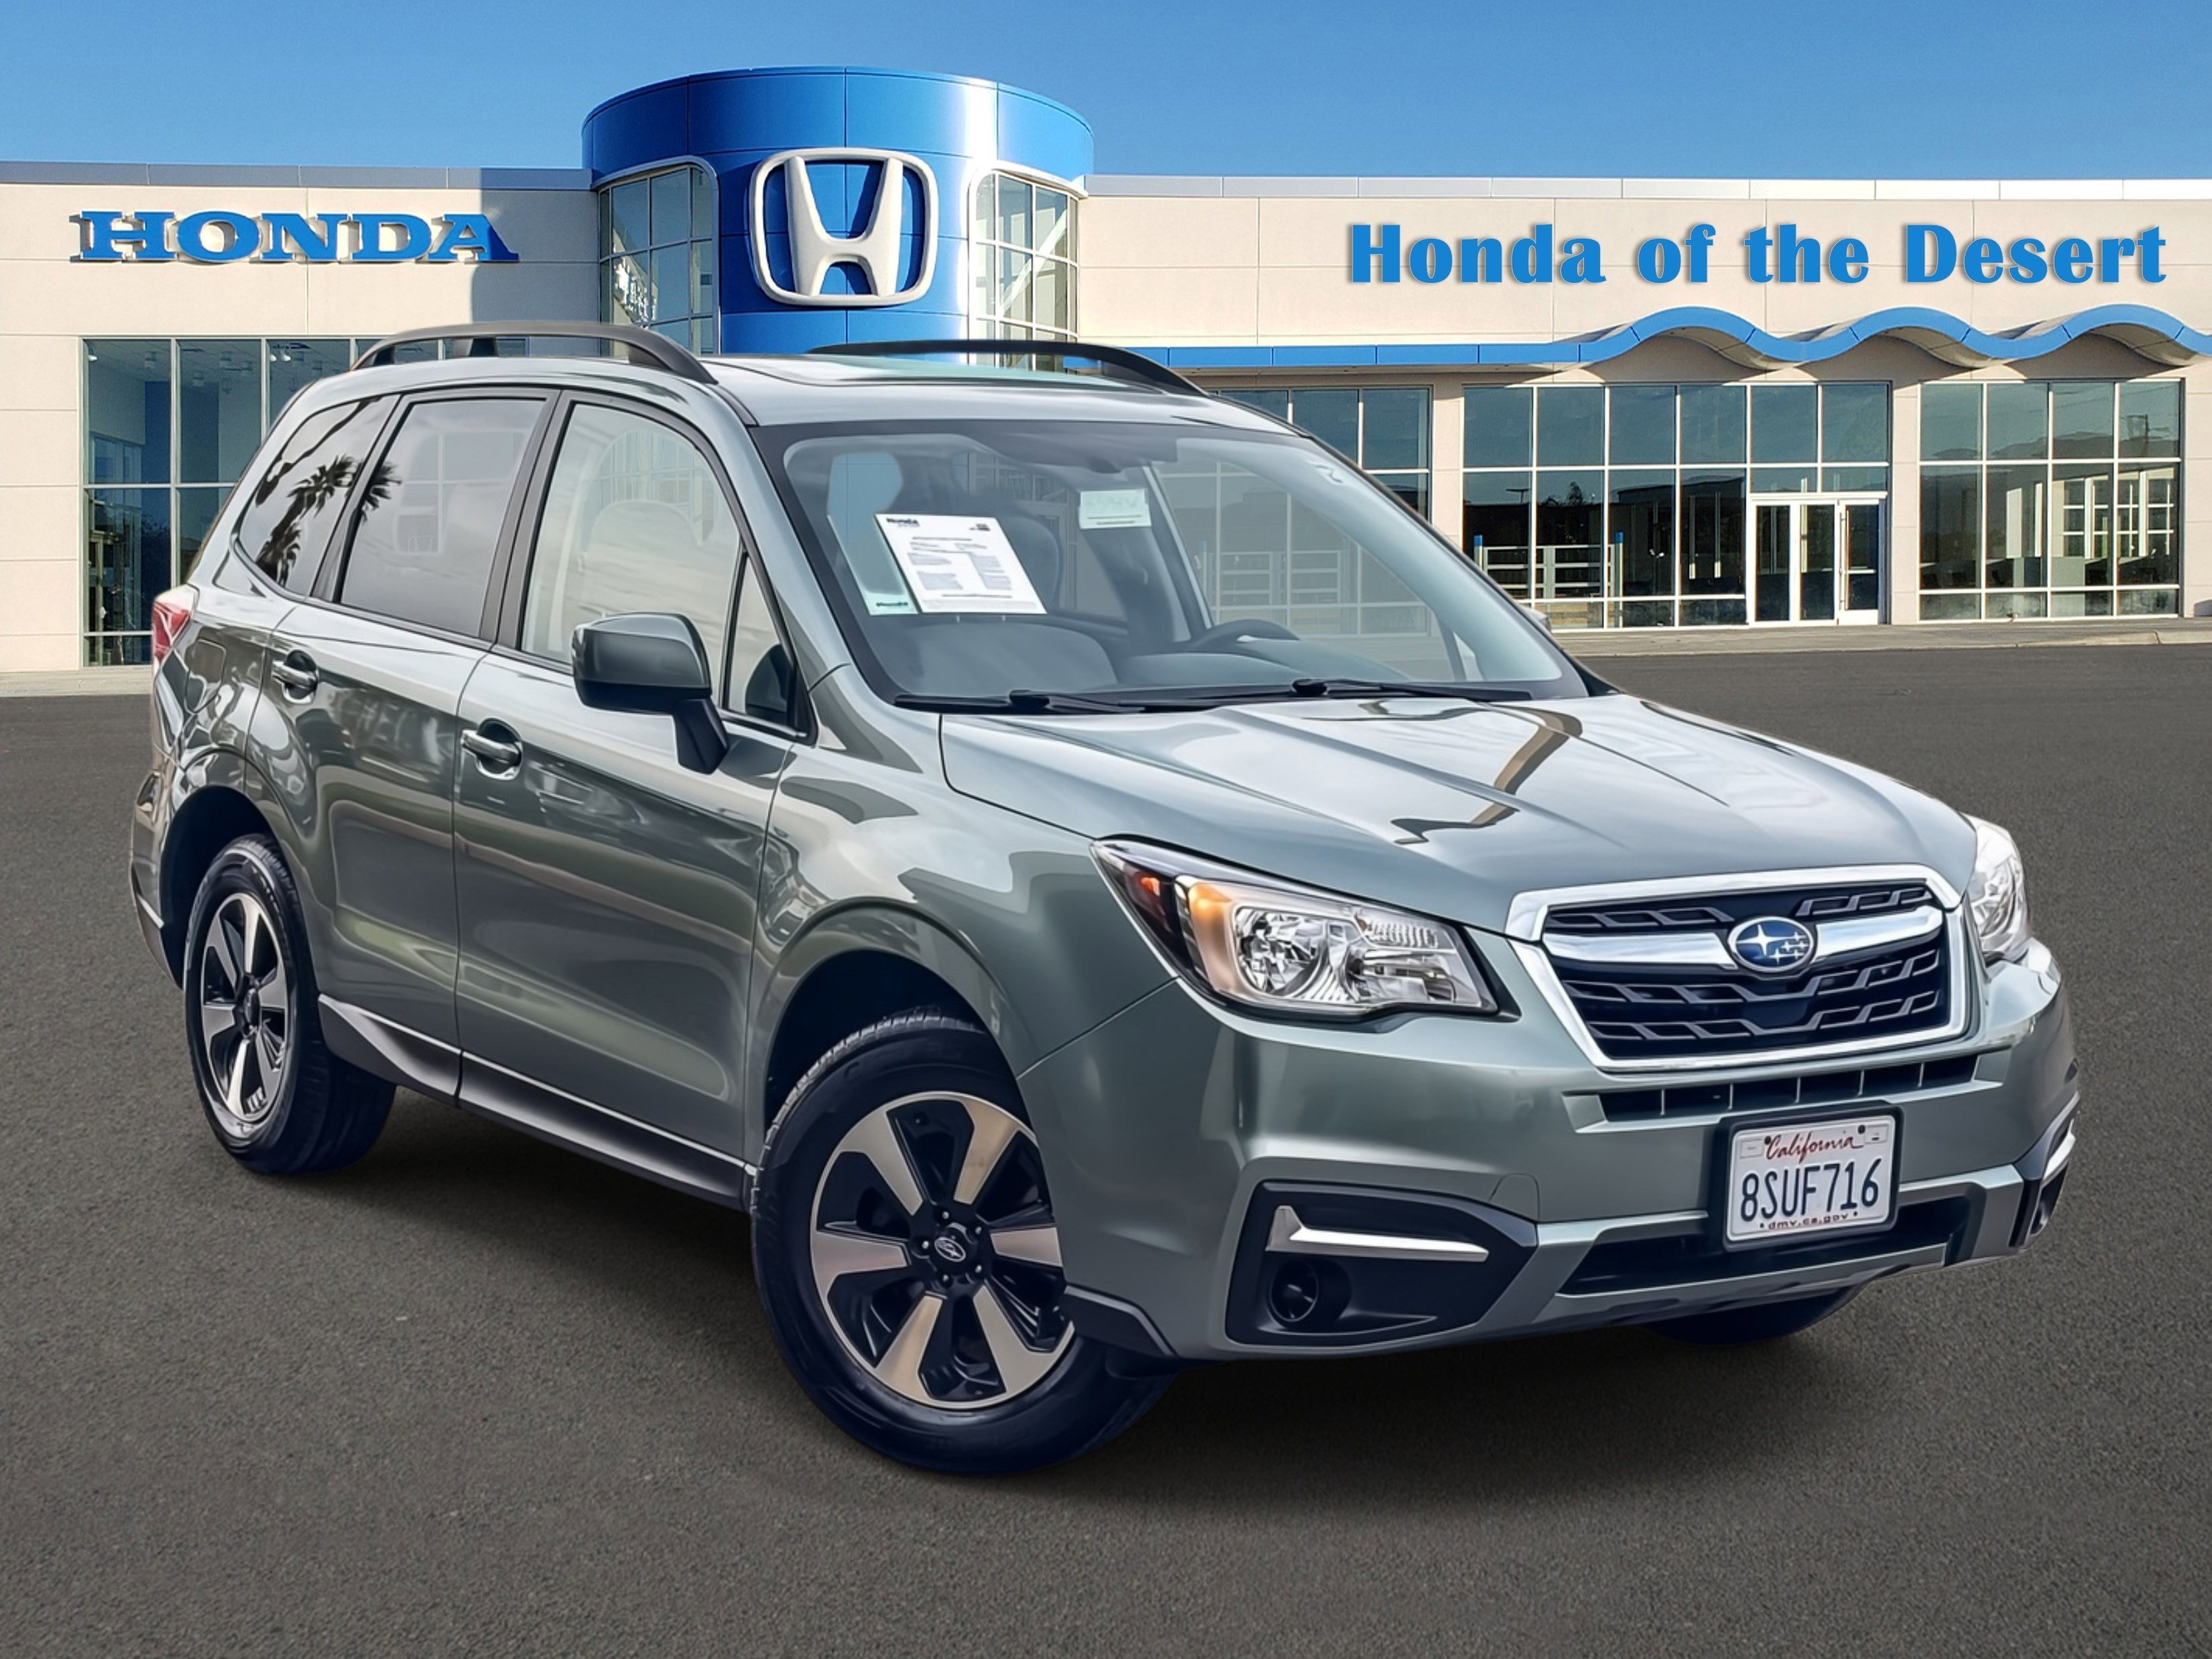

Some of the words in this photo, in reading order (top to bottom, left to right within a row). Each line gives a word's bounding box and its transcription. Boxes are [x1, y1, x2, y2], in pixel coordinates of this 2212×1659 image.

[80, 210, 519, 261] HONDA
[1351, 223, 1607, 284] Honda
[1638, 223, 1716, 284] of
[1743, 223, 1869, 284] the
[1906, 224, 2167, 284] Desert
[1766, 1131, 1863, 1163] California
[1741, 1158, 1882, 1222] 8SUF716
[1768, 1213, 1849, 1229] dmv.ca.gov
